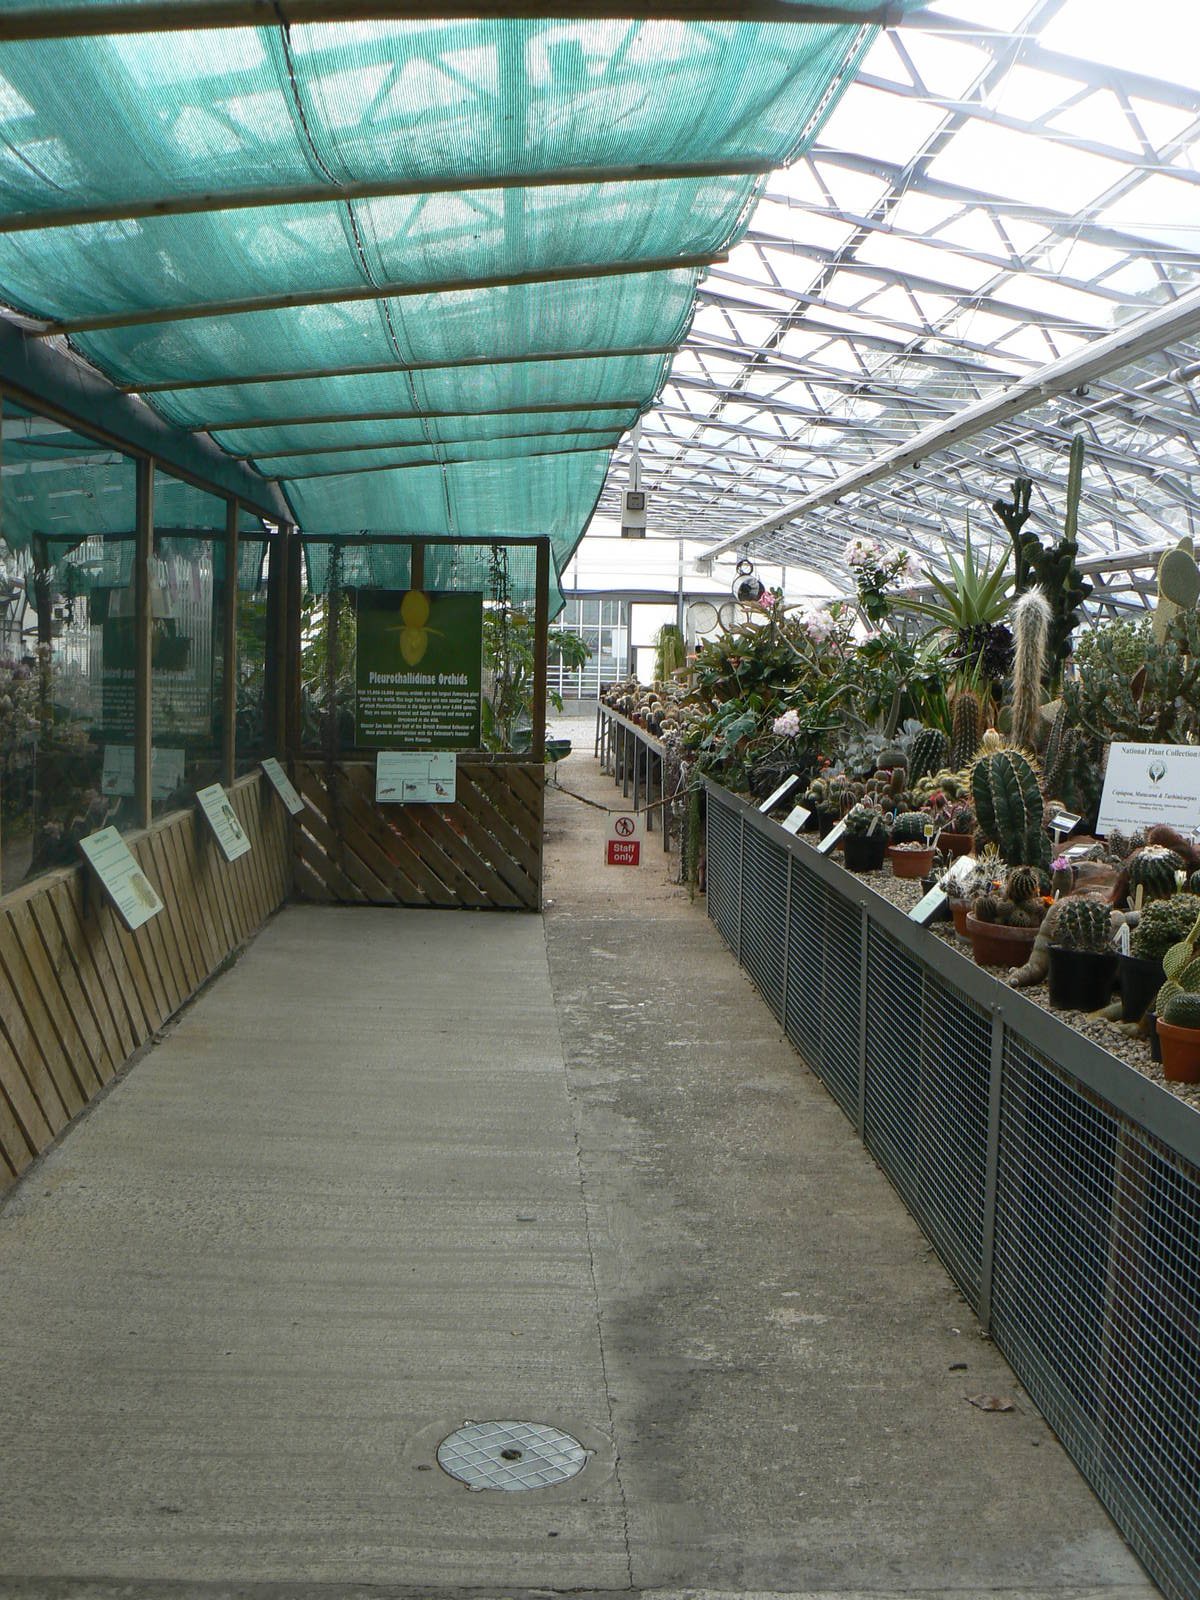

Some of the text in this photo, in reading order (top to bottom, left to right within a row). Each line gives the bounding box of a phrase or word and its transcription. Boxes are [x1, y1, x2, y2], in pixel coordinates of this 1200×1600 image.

[369, 671, 468, 685] Pleurothallidinae Orchids
[1122, 746, 1198, 757] National Plant Collection
[614, 843, 635, 853] Staff
[614, 853, 634, 862] only
